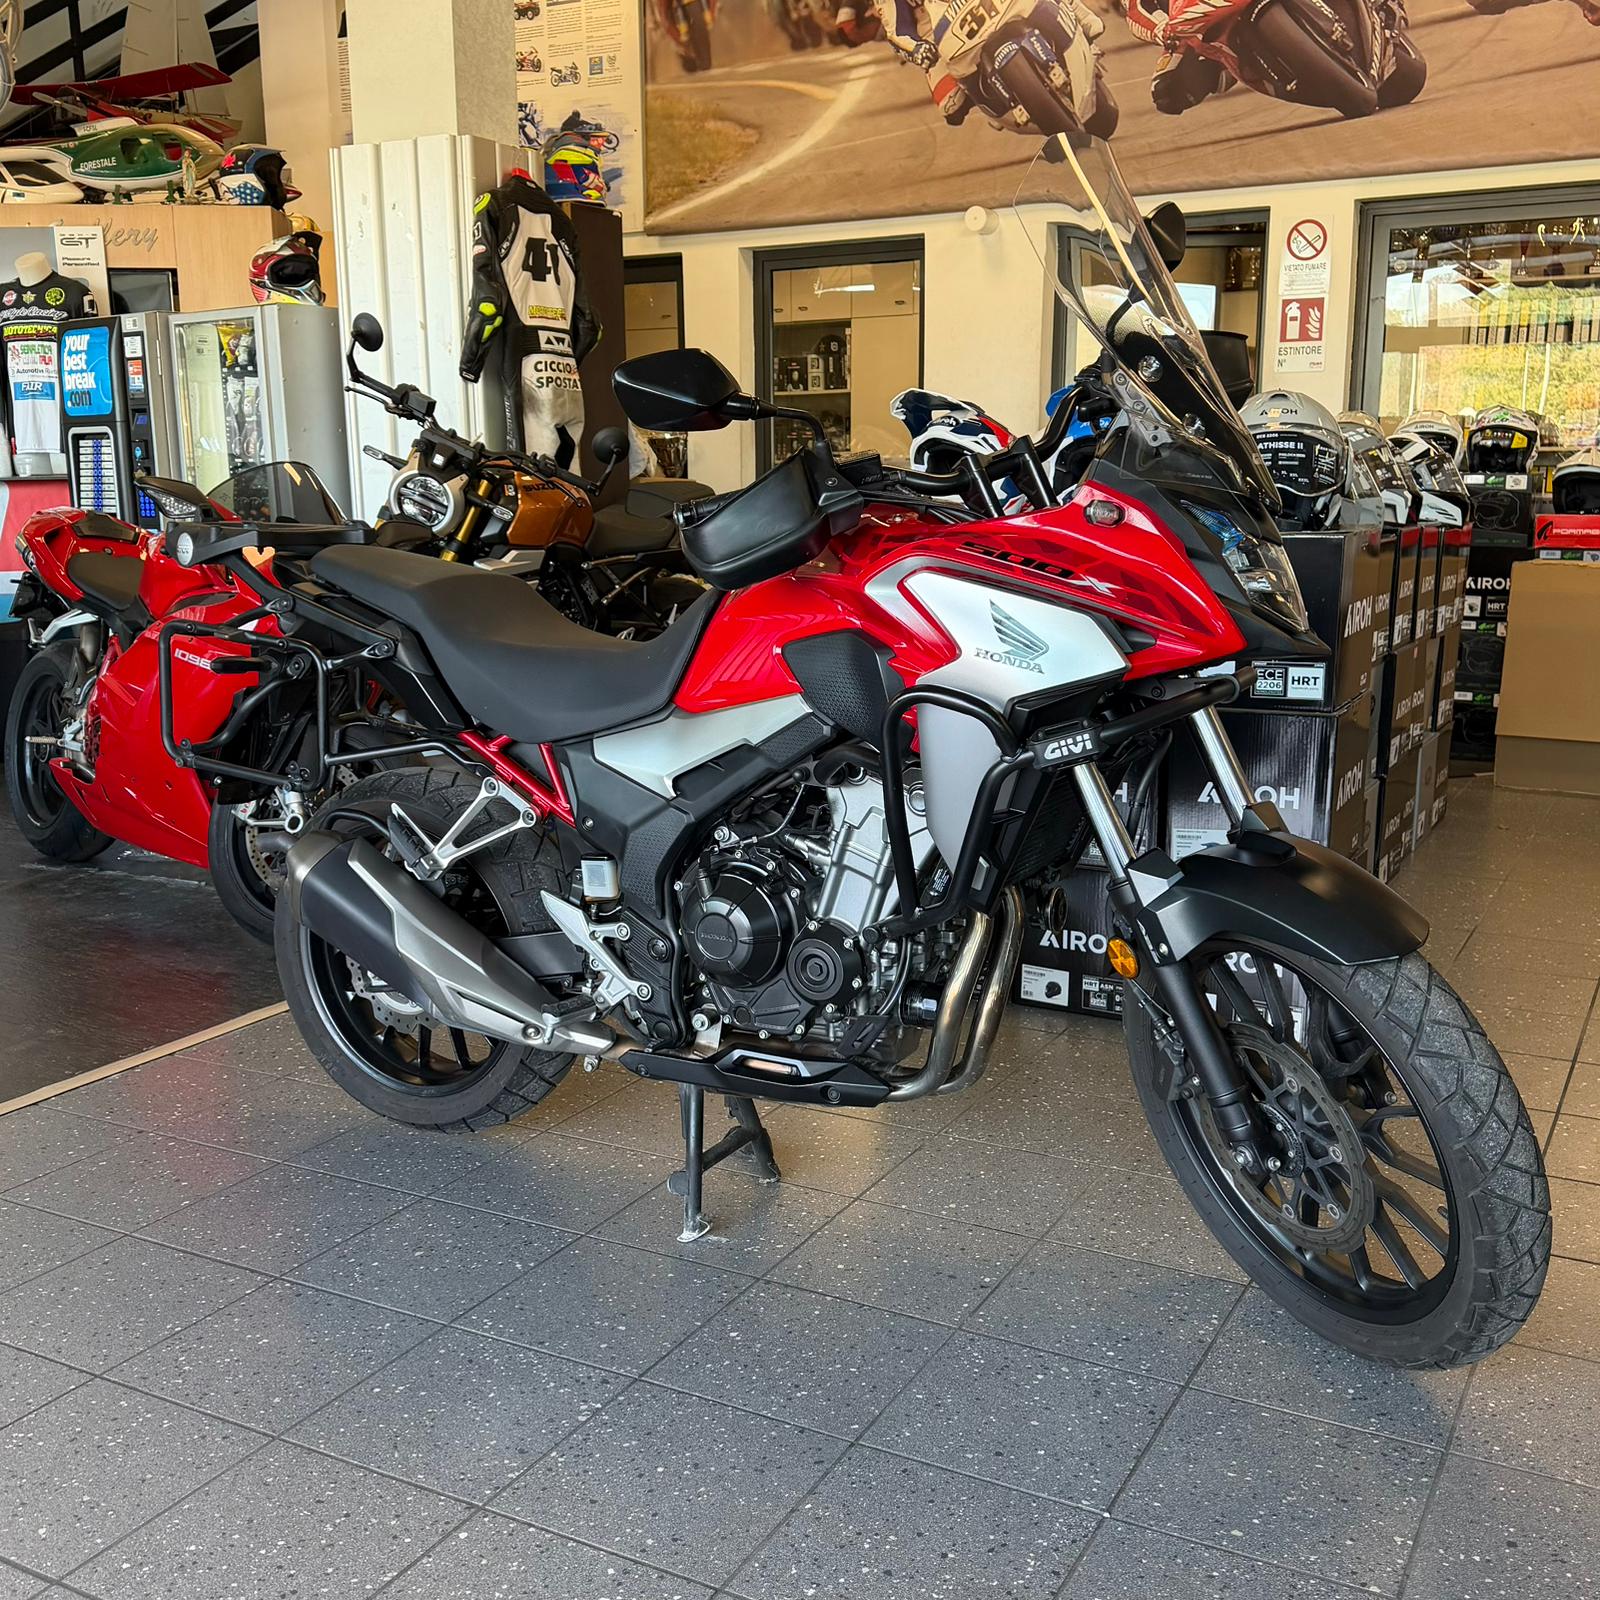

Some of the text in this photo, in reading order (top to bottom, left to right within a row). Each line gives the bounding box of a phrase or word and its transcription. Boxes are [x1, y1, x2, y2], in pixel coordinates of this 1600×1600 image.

[79, 157, 117, 171] FORESTALE
[521, 236, 560, 284] 41
[64, 334, 90, 352] your
[1278, 345, 1322, 356] ESTINTORE
[63, 352, 87, 371] best
[534, 361, 572, 373] CICCIO
[64, 371, 96, 392] break
[536, 376, 580, 388] SPOSTA
[67, 390, 92, 407] .com
[1257, 442, 1296, 450] ATHISSE
[1487, 602, 1506, 610] HRT
[1344, 595, 1373, 638] AIROH
[974, 647, 1045, 674] HONDA
[1257, 681, 1282, 689] 2206
[1291, 676, 1320, 686] HRT
[1336, 759, 1364, 812] AIROH
[1197, 781, 1301, 810] AOH
[1039, 929, 1107, 955] AIRO
